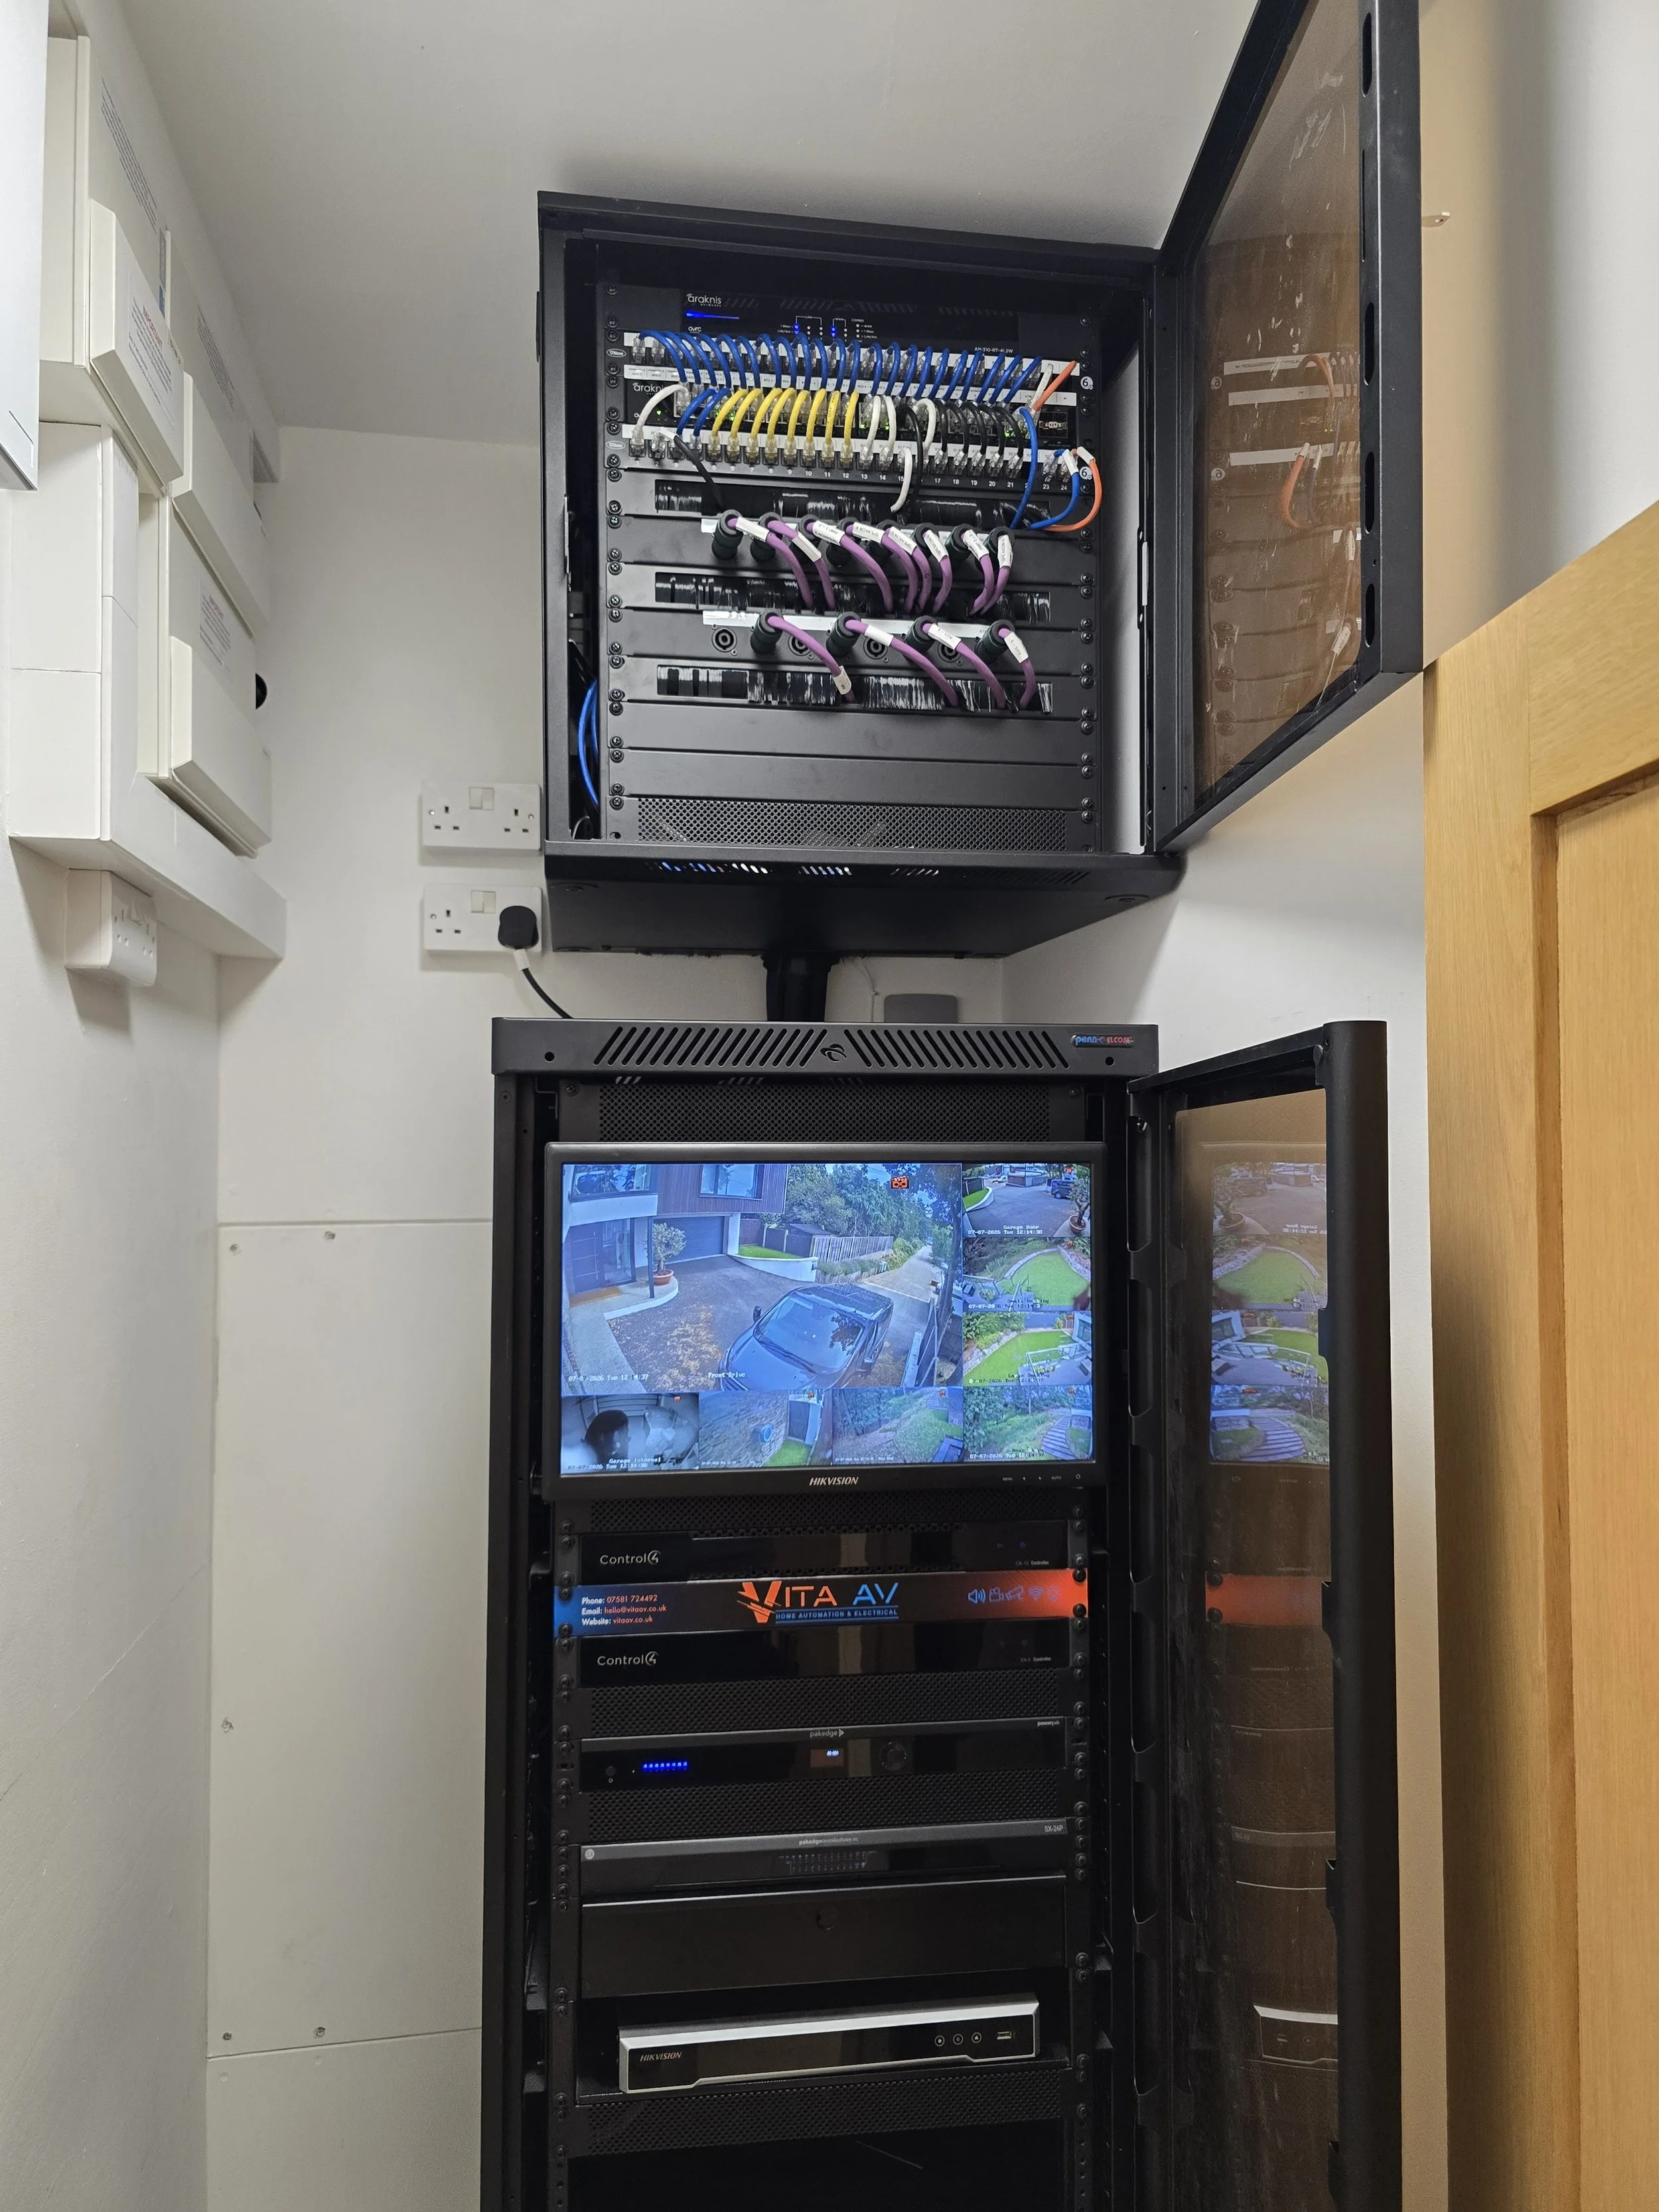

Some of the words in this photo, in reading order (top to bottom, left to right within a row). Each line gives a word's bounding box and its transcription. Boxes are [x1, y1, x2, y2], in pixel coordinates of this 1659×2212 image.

[687, 295, 721, 305] araknis
[634, 384, 664, 393] arakni
[859, 527, 879, 537] SPEAKON
[893, 532, 912, 549] SPEAKON
[927, 536, 942, 555] SPEAKON
[809, 1477, 859, 1486] HIKVISION
[600, 1550, 662, 1565] Control4
[581, 1596, 605, 1605] Phone:
[630, 1594, 658, 1603] 724492
[737, 1581, 837, 1623] VITA
[853, 1582, 899, 1605] AV
[581, 1607, 603, 1615] Email:
[604, 1603, 667, 1615] hello@vitaav.co.uk
[854, 1608, 898, 1617] ELECTRICAL
[581, 1617, 611, 1626] Website:
[613, 1615, 654, 1624] vitaav.co.uk
[597, 1651, 659, 1666] Control4
[810, 1729, 838, 1738] pakedge
[640, 2051, 682, 2062] HIKVISION
